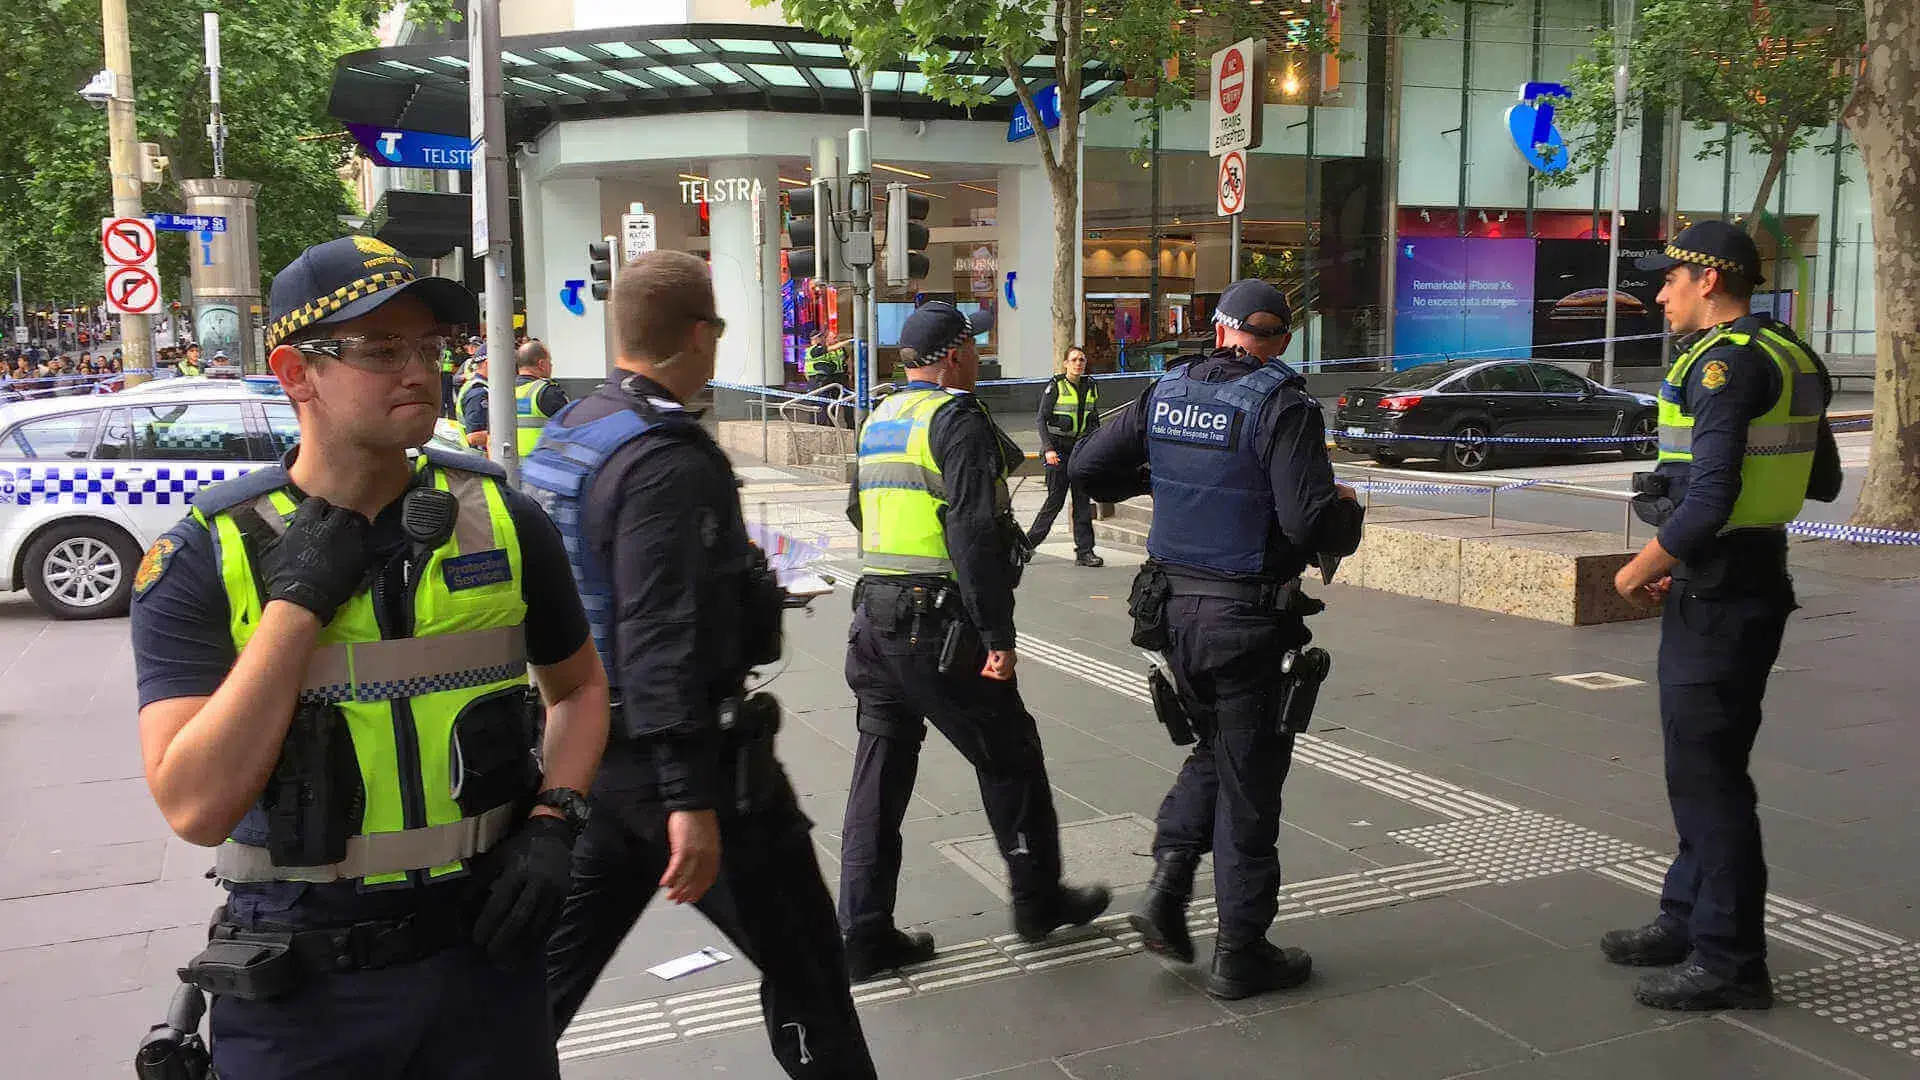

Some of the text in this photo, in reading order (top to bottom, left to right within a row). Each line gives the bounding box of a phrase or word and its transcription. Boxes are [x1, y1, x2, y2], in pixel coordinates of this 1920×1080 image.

[1220, 113, 1241, 130] TRAMS
[1215, 128, 1246, 149] EXCEPTED
[421, 148, 473, 164] TELST
[678, 177, 762, 204] TELSTRA
[172, 215, 224, 227] Bourke St
[632, 241, 647, 249] FOR
[1413, 280, 1466, 291] Remarkable
[1412, 296, 1426, 307] No
[1427, 298, 1458, 307] excess
[1460, 296, 1480, 307] data
[1153, 401, 1228, 431] Police
[1151, 425, 1225, 441] Public Order Response Team
